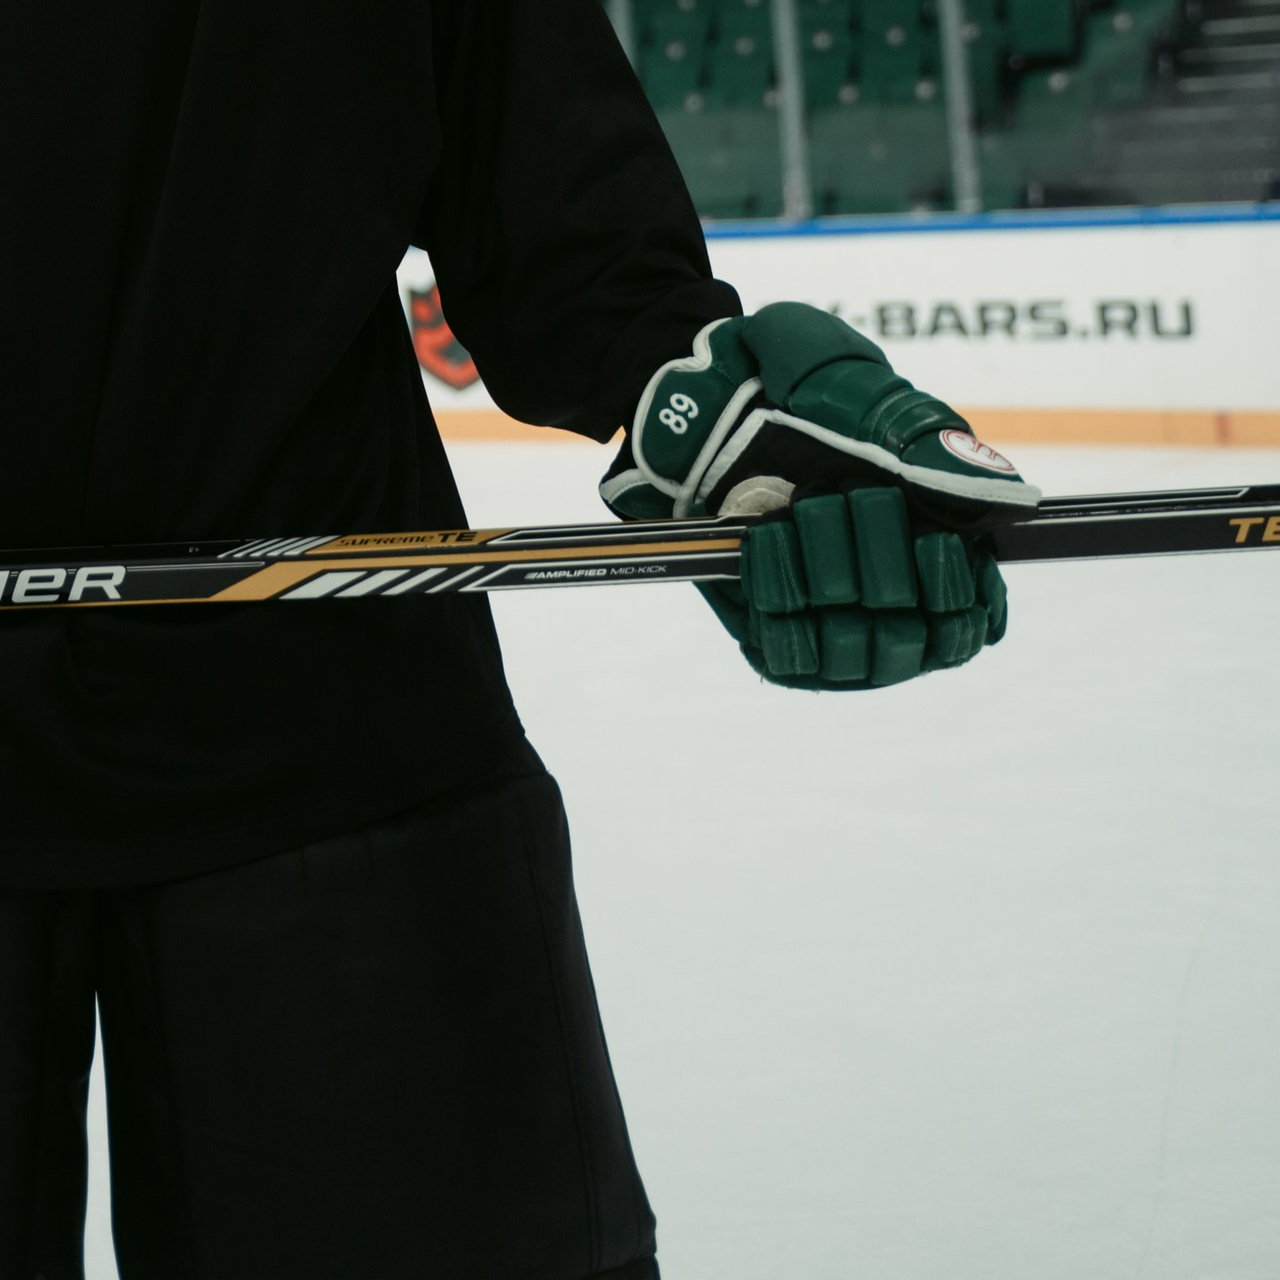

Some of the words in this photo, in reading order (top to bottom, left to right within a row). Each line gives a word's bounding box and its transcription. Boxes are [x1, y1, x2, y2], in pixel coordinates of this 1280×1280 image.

[830, 298, 1195, 338] -BARS.RU
[658, 392, 700, 435] 89
[437, 531, 479, 544] TE
[534, 567, 608, 580] AMPLIFIED
